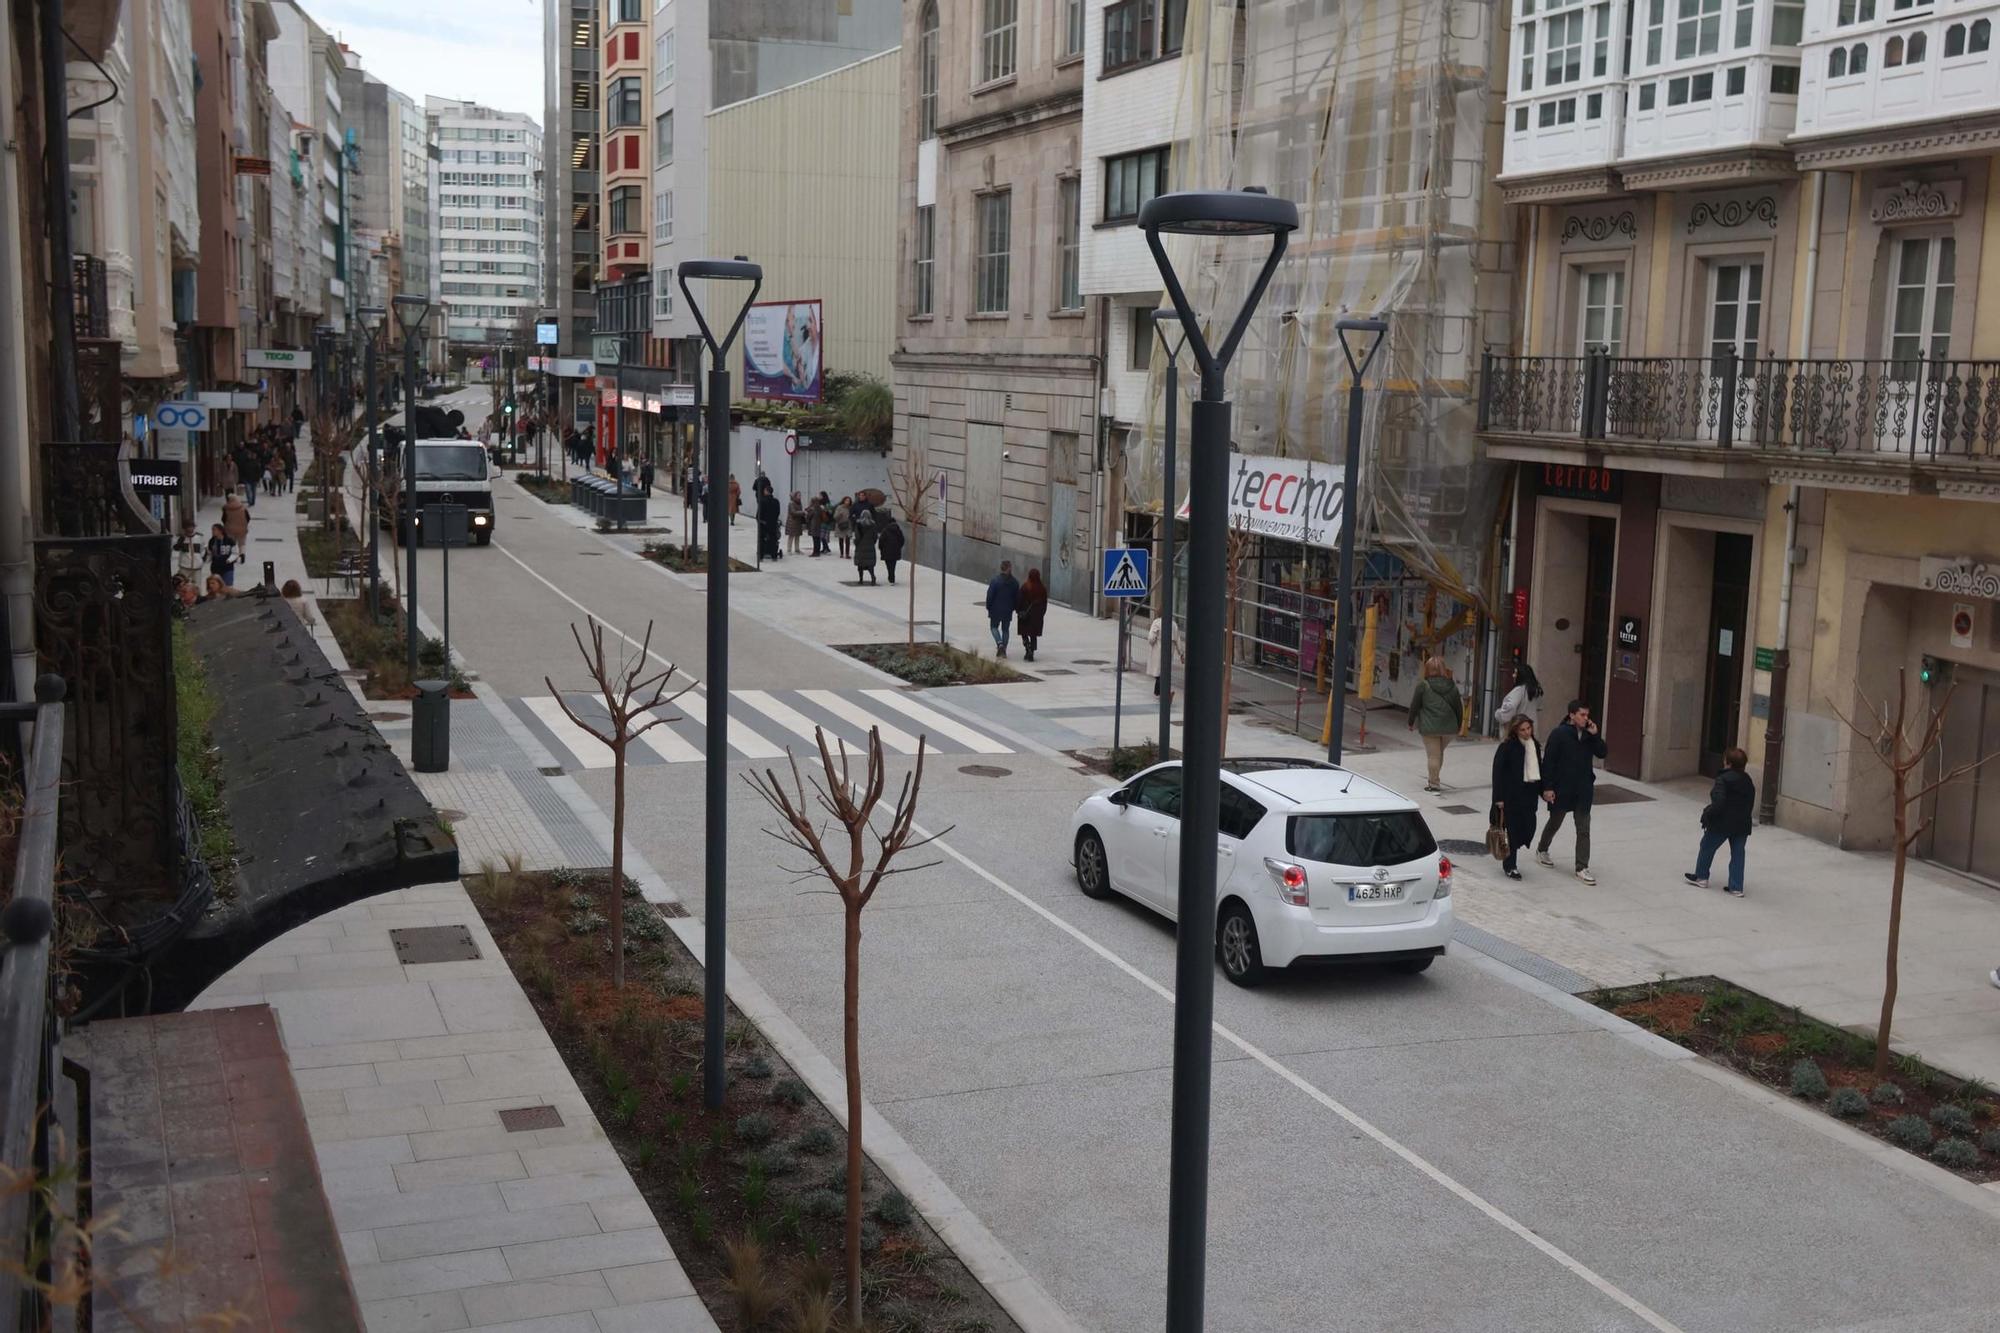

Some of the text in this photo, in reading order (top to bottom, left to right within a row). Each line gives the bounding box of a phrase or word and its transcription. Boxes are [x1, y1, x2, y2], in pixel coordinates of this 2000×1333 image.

[1231, 459, 1344, 521] teccmo
[1356, 887, 1402, 900] 4625 HXP
